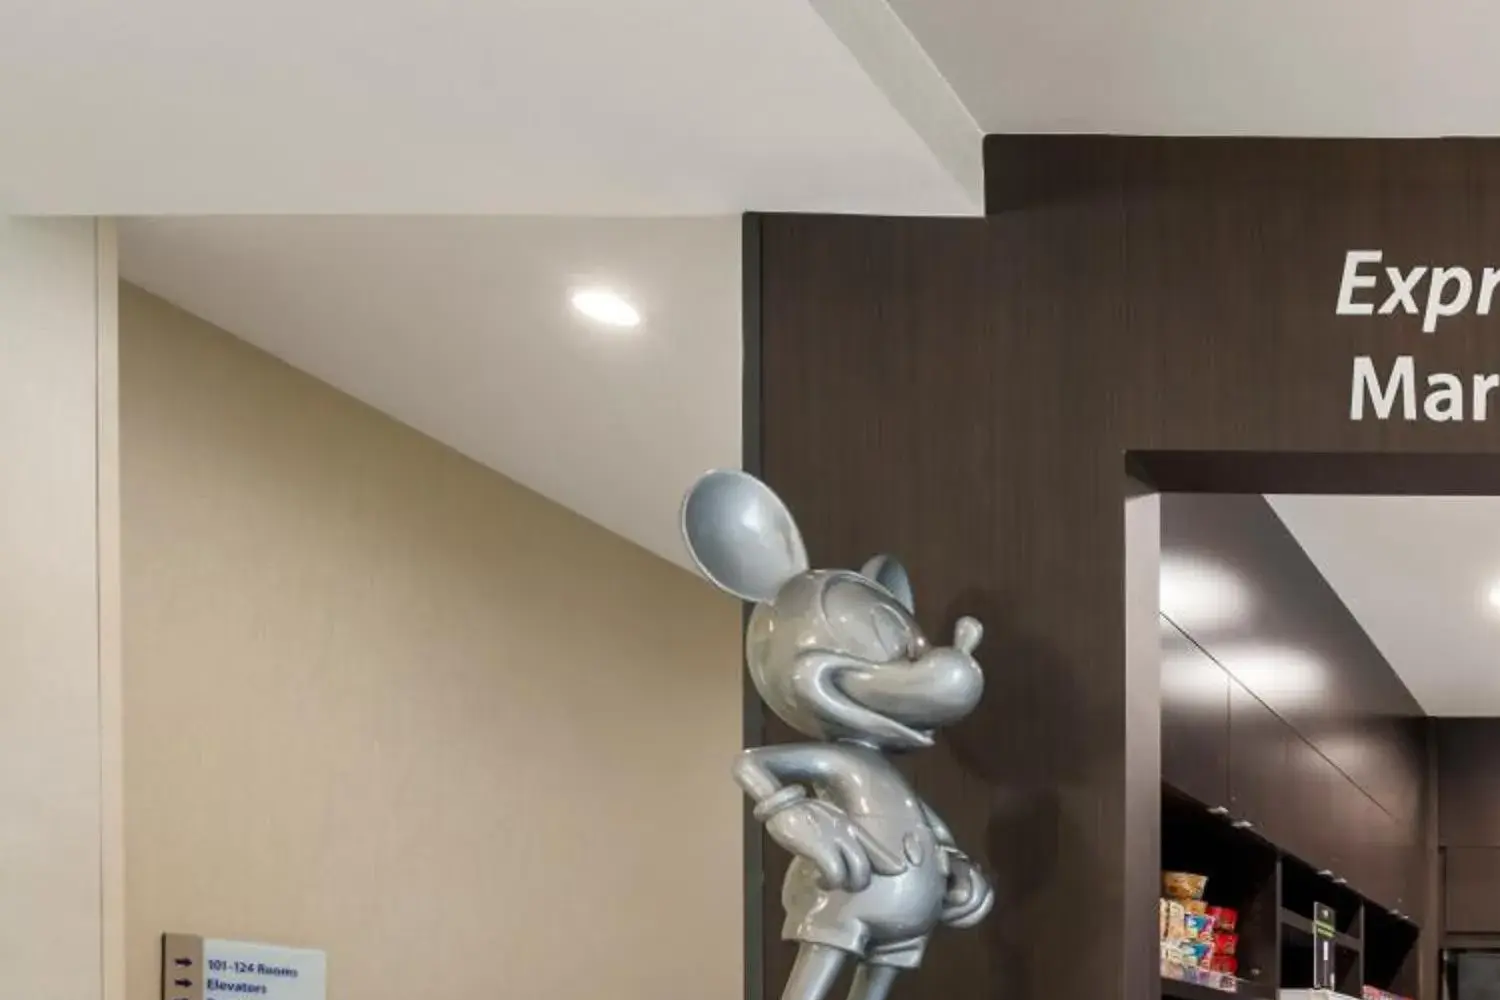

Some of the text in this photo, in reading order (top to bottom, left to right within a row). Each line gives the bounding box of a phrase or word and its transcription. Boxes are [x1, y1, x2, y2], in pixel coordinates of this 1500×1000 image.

[207, 959, 298, 978] 101-124 Rooms
[206, 978, 267, 994] Elevators
